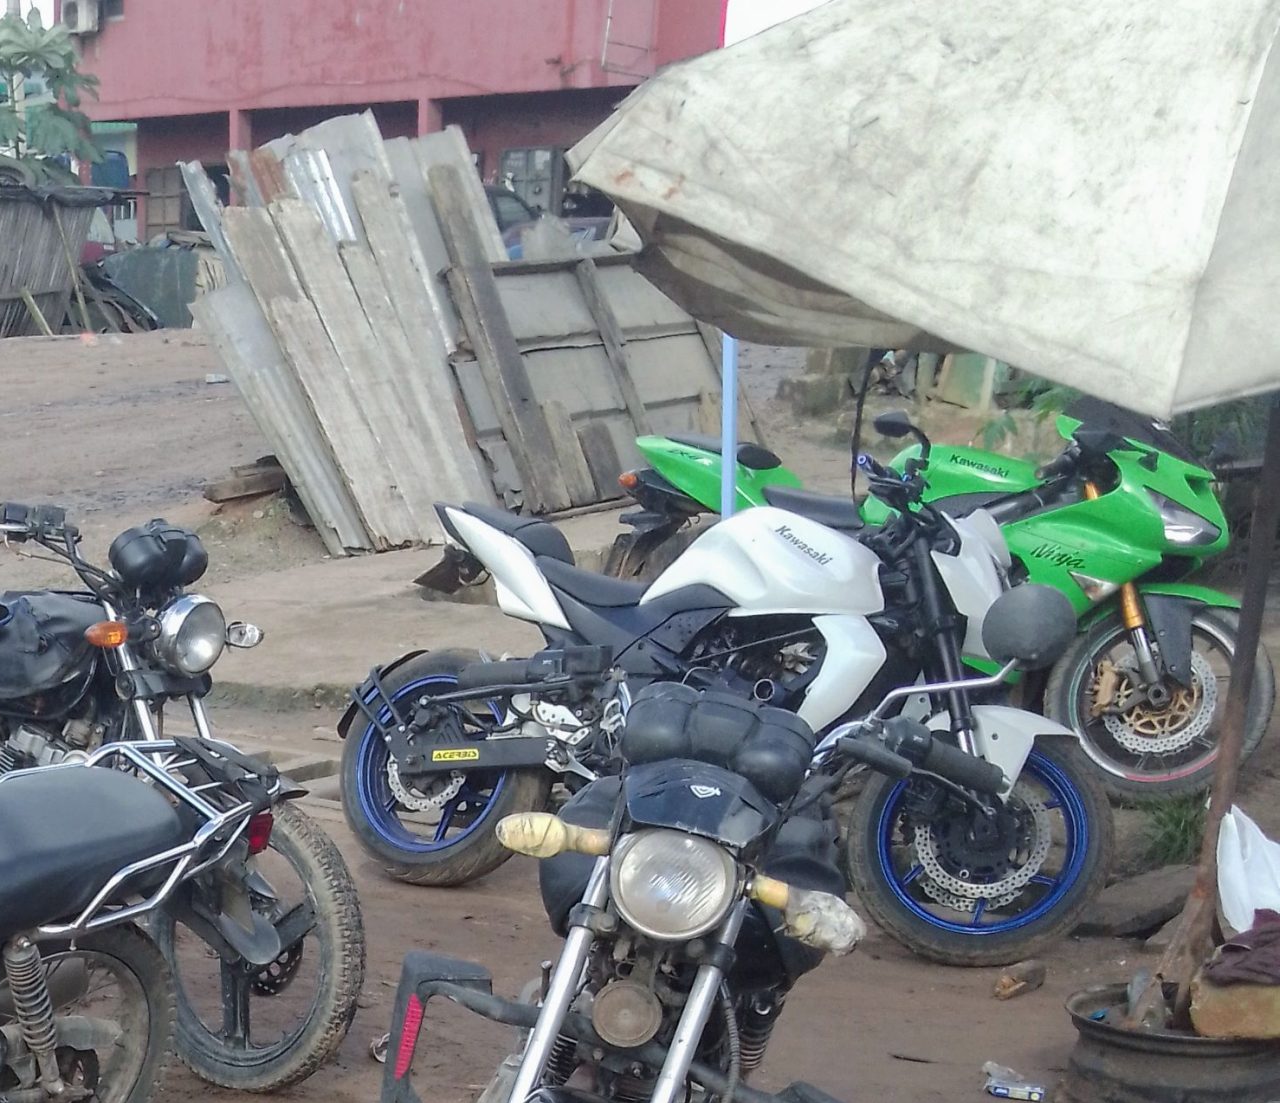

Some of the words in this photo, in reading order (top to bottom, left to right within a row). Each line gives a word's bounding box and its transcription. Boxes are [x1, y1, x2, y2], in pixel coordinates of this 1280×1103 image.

[949, 453, 1010, 479] Kawasaki
[775, 525, 834, 566] Kawasaki
[1028, 543, 1086, 569] Ninja
